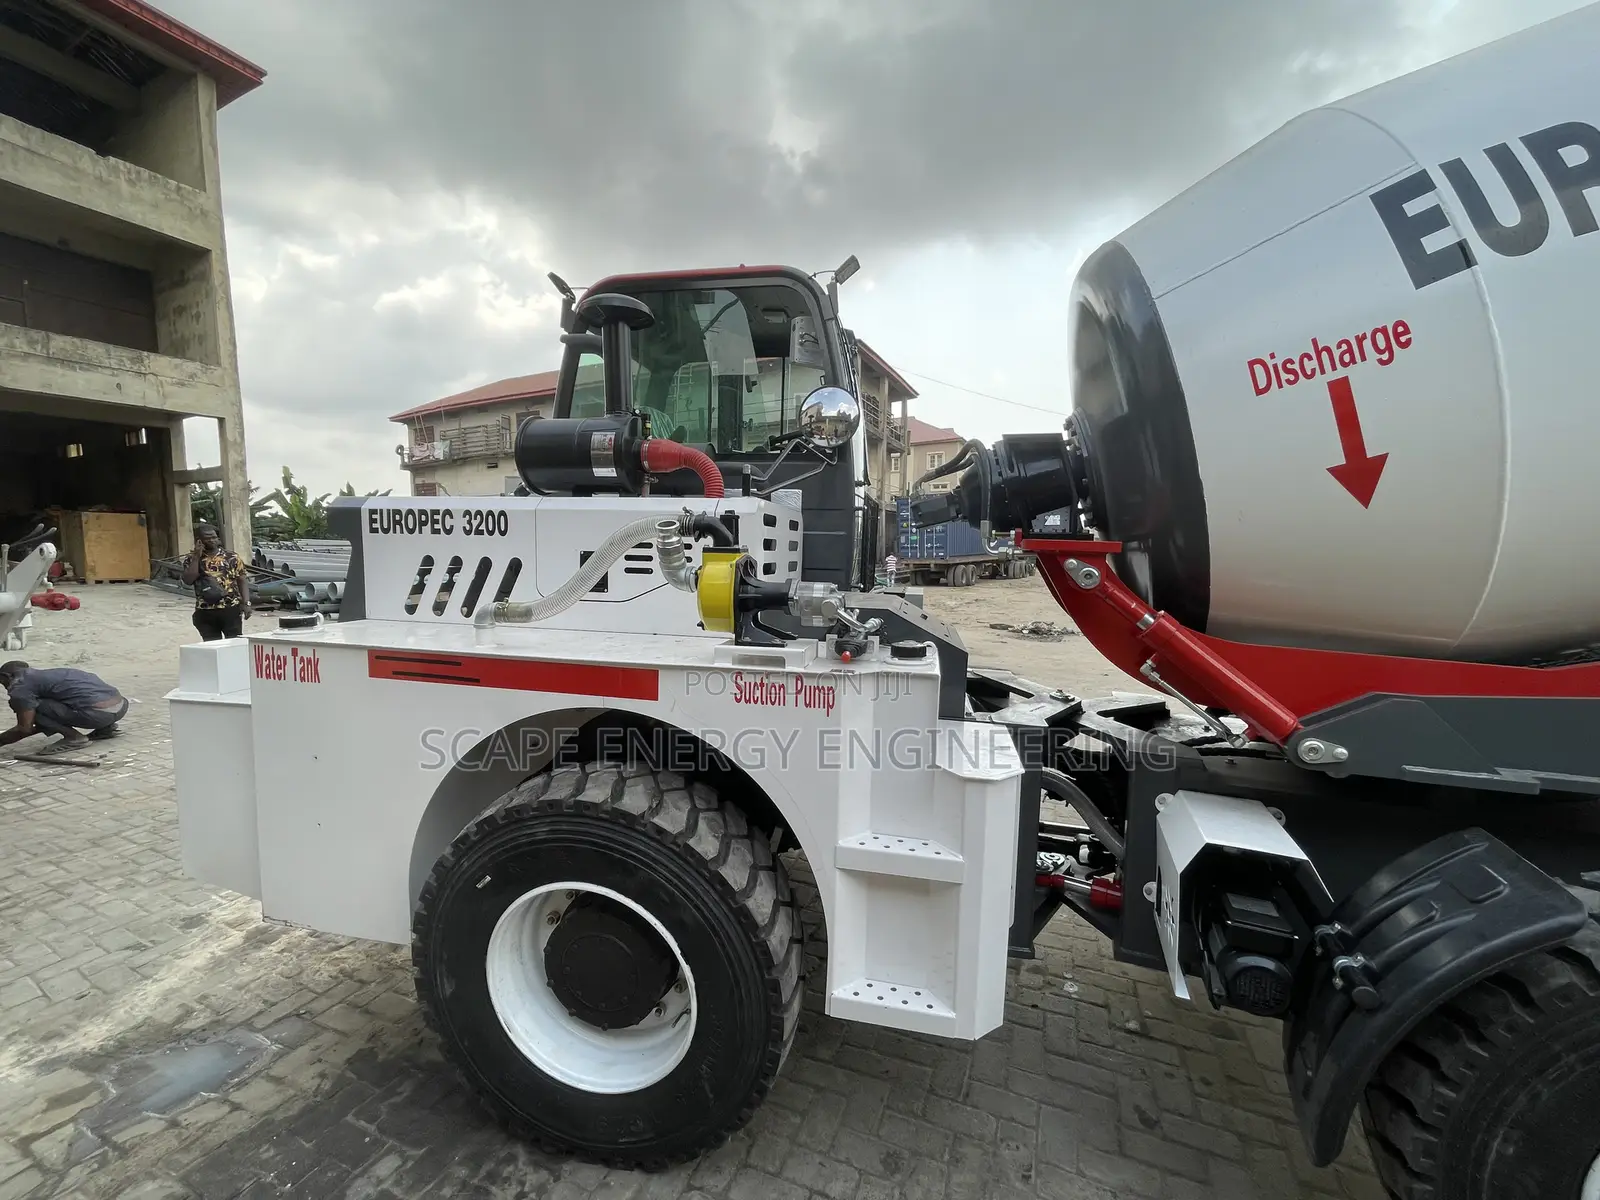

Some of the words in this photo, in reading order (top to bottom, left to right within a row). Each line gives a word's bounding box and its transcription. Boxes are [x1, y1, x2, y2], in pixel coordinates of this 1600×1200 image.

[1247, 319, 1413, 397] Discharge
[368, 508, 454, 536] EUROPEC
[462, 509, 509, 536] 3200
[253, 644, 288, 681] Water
[291, 647, 321, 684] Tank
[734, 671, 786, 707] Suction
[795, 674, 835, 717] Pump
